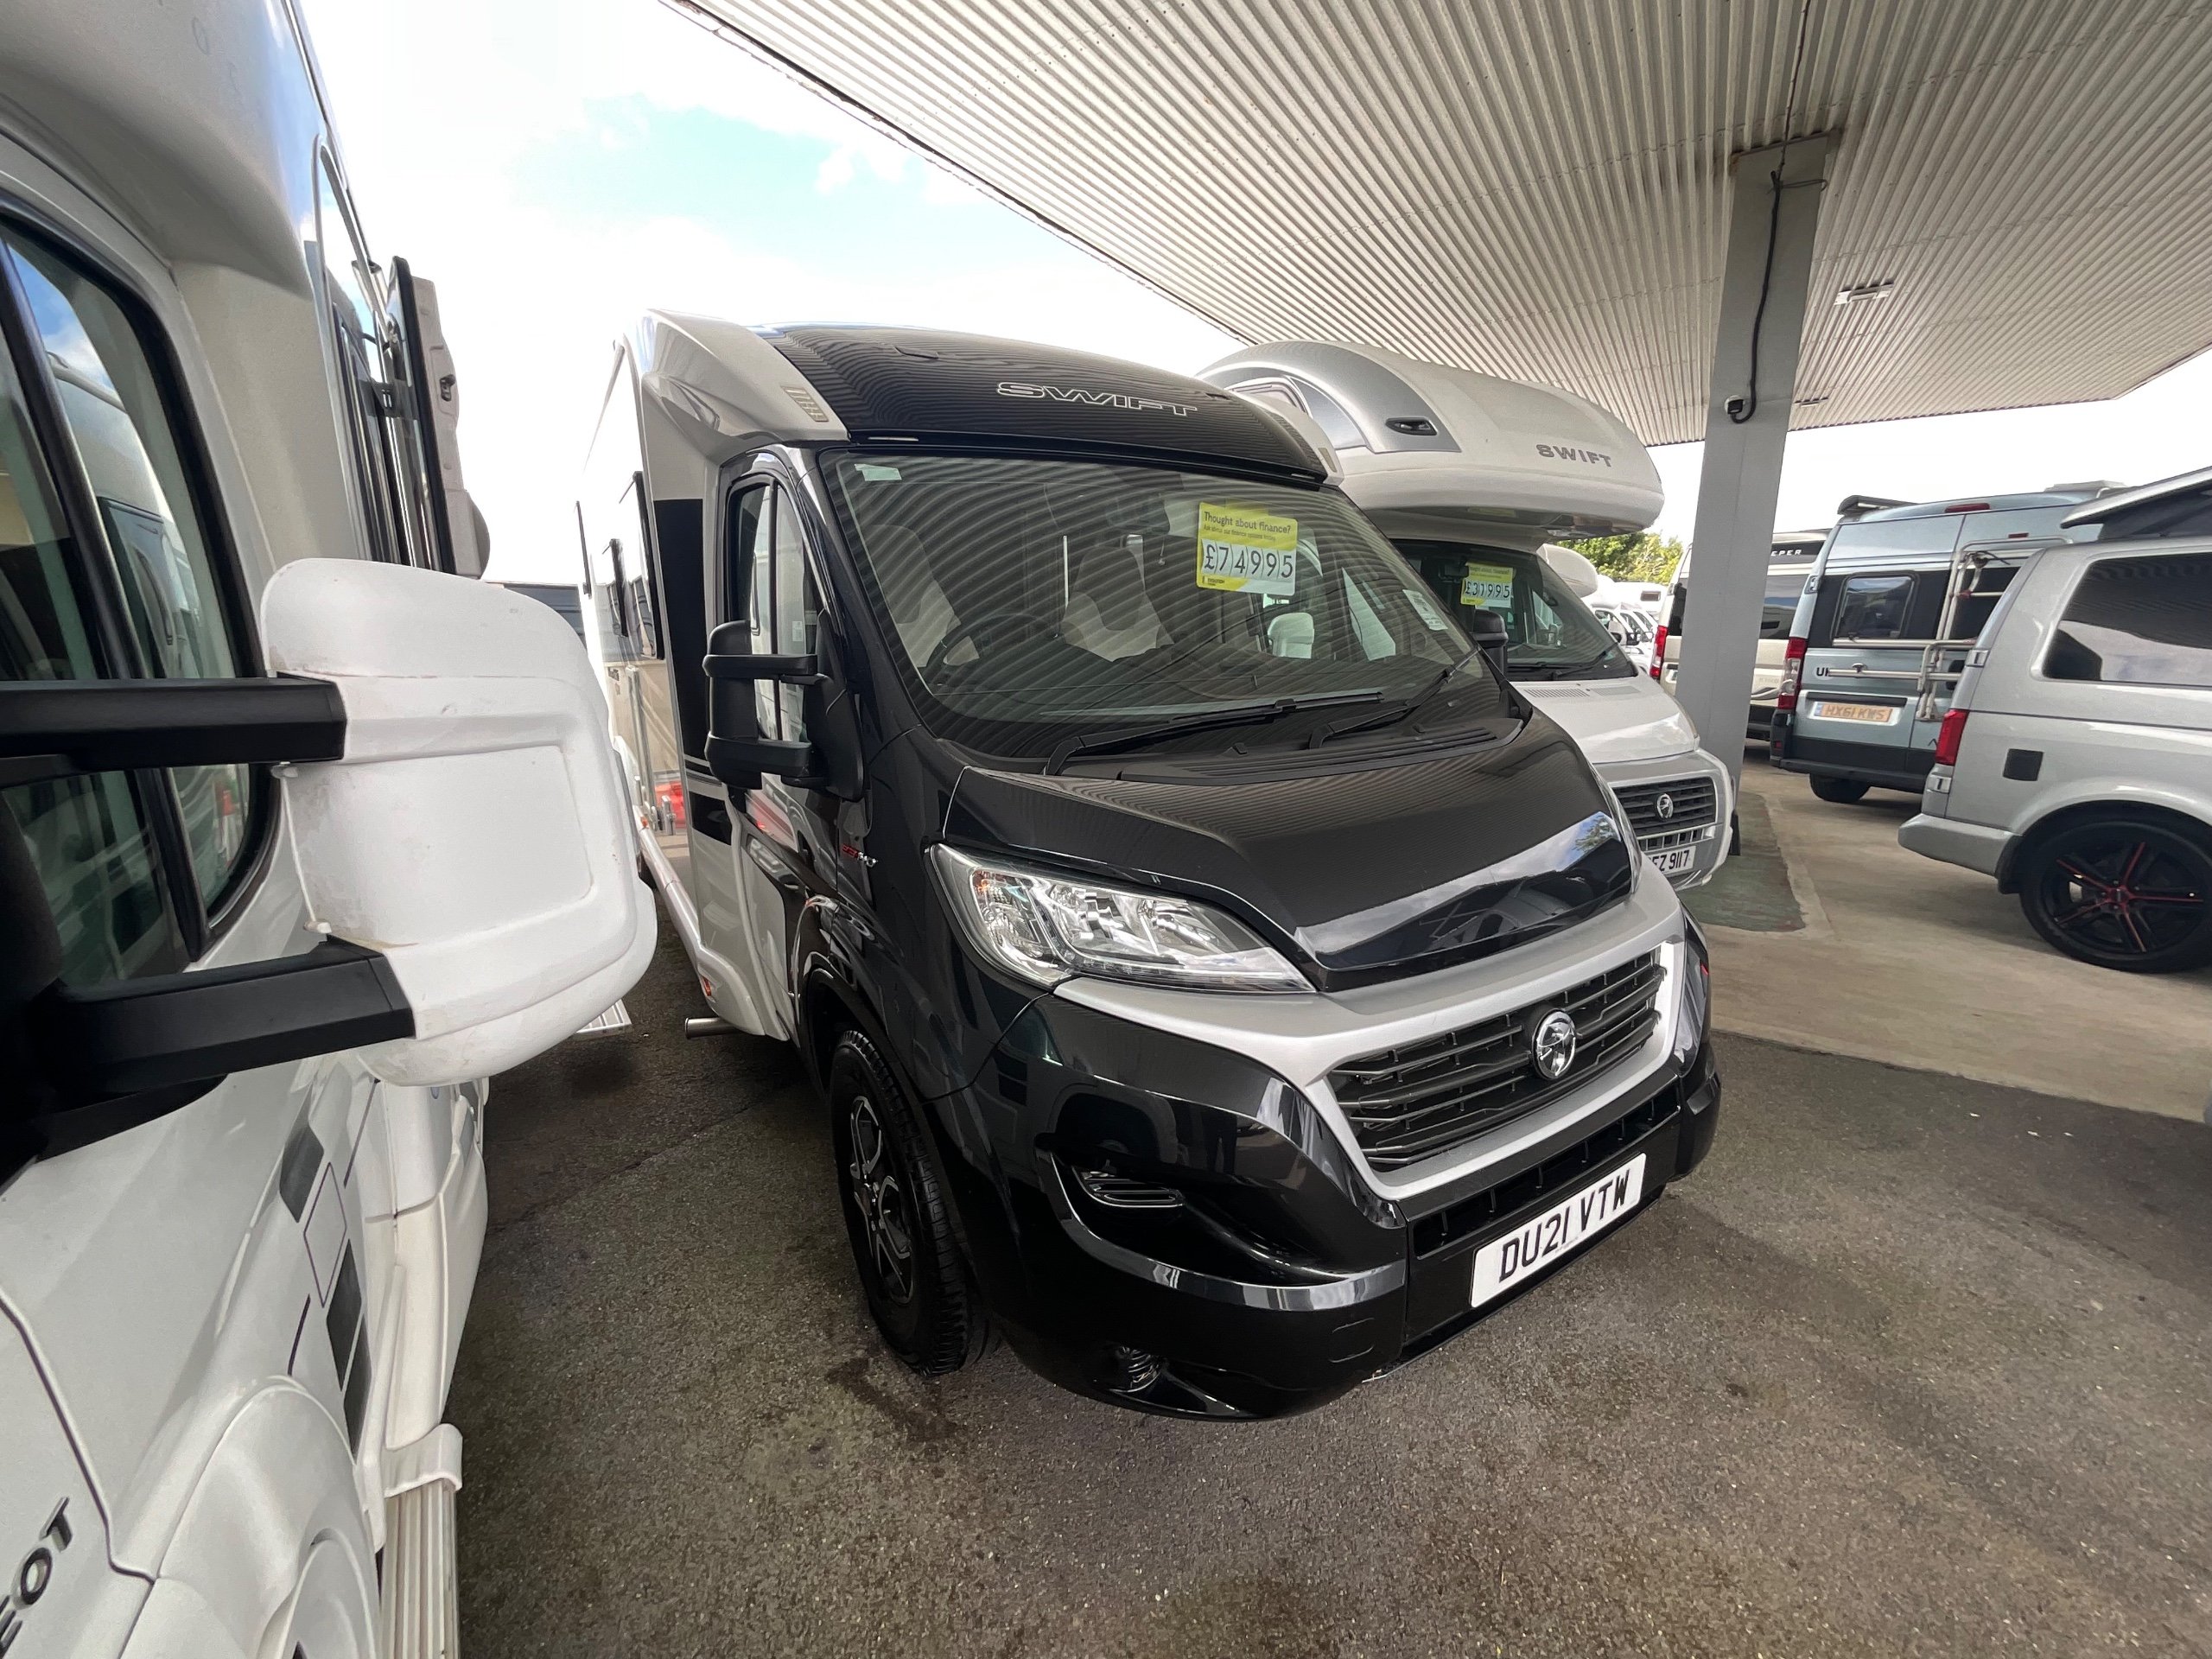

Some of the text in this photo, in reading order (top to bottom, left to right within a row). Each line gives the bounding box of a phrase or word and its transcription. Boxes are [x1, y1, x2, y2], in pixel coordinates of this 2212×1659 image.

[997, 381, 1198, 416] SWIFT
[1535, 444, 1611, 467] SWIFT
[1205, 512, 1291, 534] Thought about finance?
[1204, 543, 1293, 578] £74995
[1499, 1168, 1630, 1283] DU21 VTW
